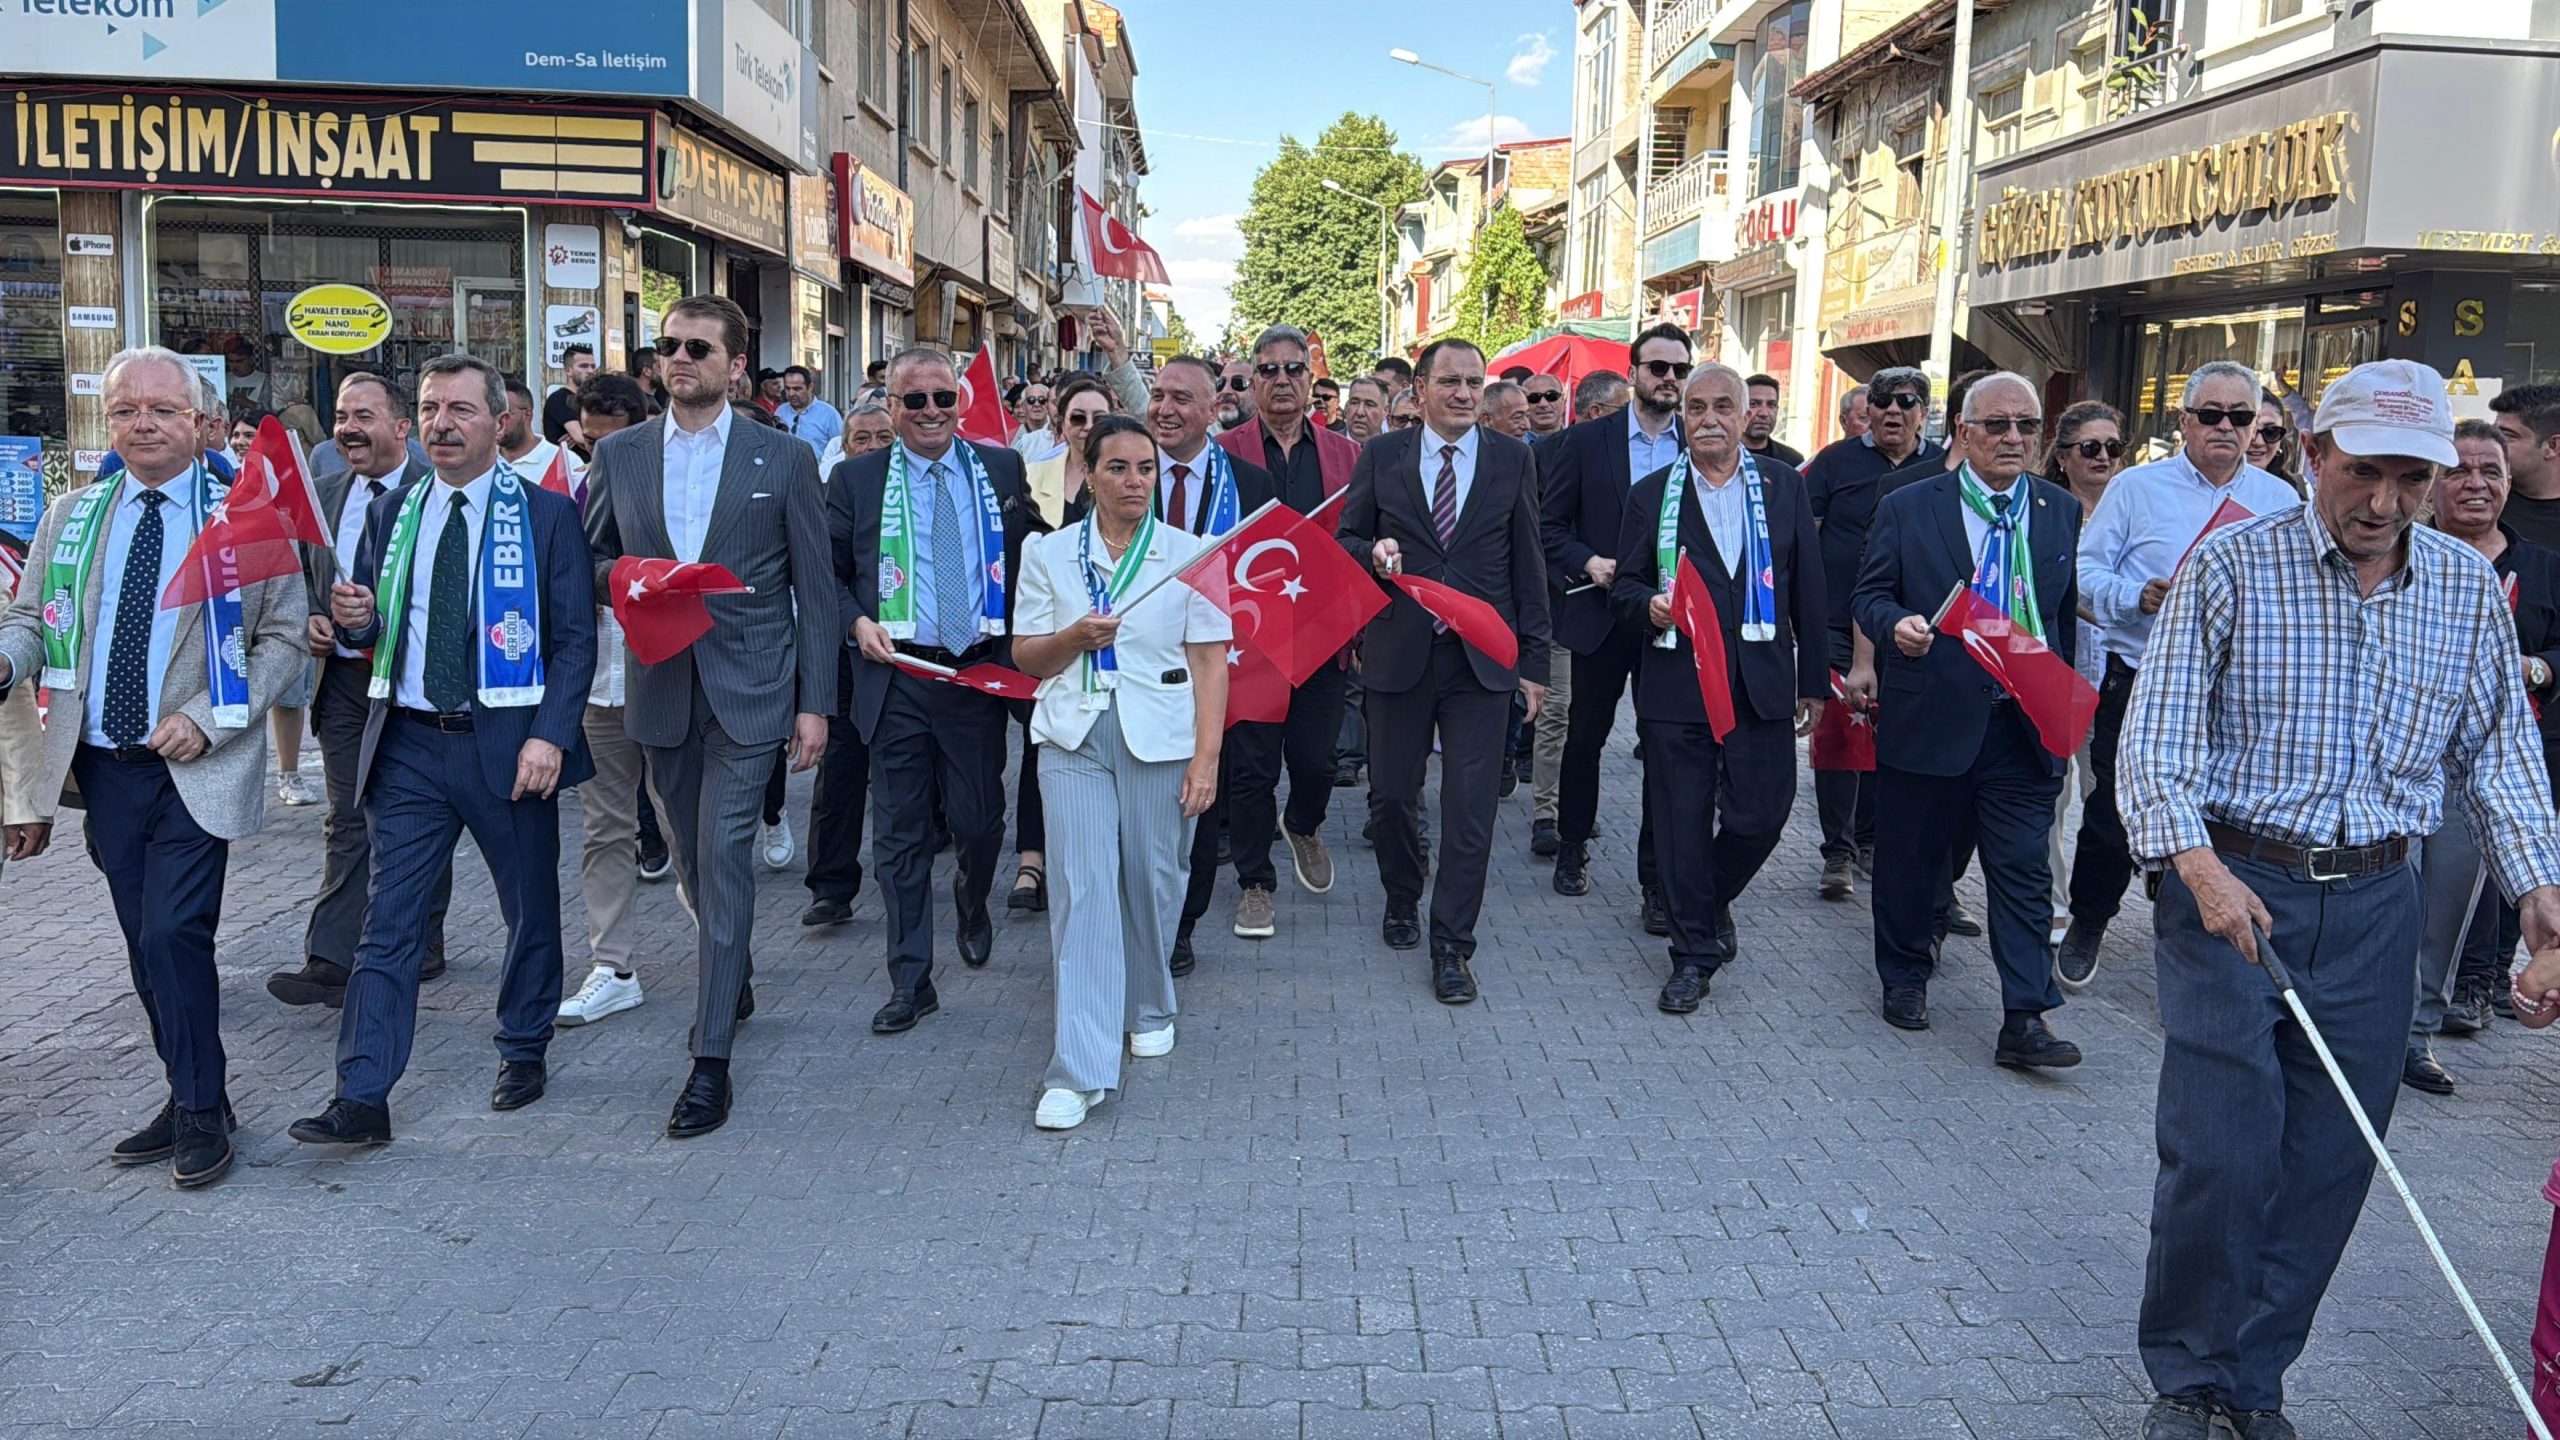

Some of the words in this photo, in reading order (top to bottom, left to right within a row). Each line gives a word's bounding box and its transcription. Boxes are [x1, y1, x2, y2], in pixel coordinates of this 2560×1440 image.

[525, 52, 597, 67] Dem-Sa
[602, 50, 667, 71] İletişim
[735, 41, 753, 81] Türk
[754, 56, 785, 104] Telekom
[16, 91, 440, 188] İLETİŞİM/İNŞAAT
[678, 134, 778, 226] DEM-SA
[2070, 111, 2350, 246] KUYUMCULUK
[83, 239, 112, 250] iPhone
[2416, 229, 2535, 254] MEHMET
[71, 312, 115, 322] SAMSUNG
[304, 307, 339, 315] HAYALET
[341, 308, 369, 316] EKRAN
[325, 320, 349, 328] NANO
[331, 330, 368, 338] KORUYUCU
[79, 452, 105, 464] Red
[52, 478, 112, 567] EBER
[493, 502, 524, 588] EBER
[884, 558, 893, 576] EBER
[505, 637, 517, 659] EBER
